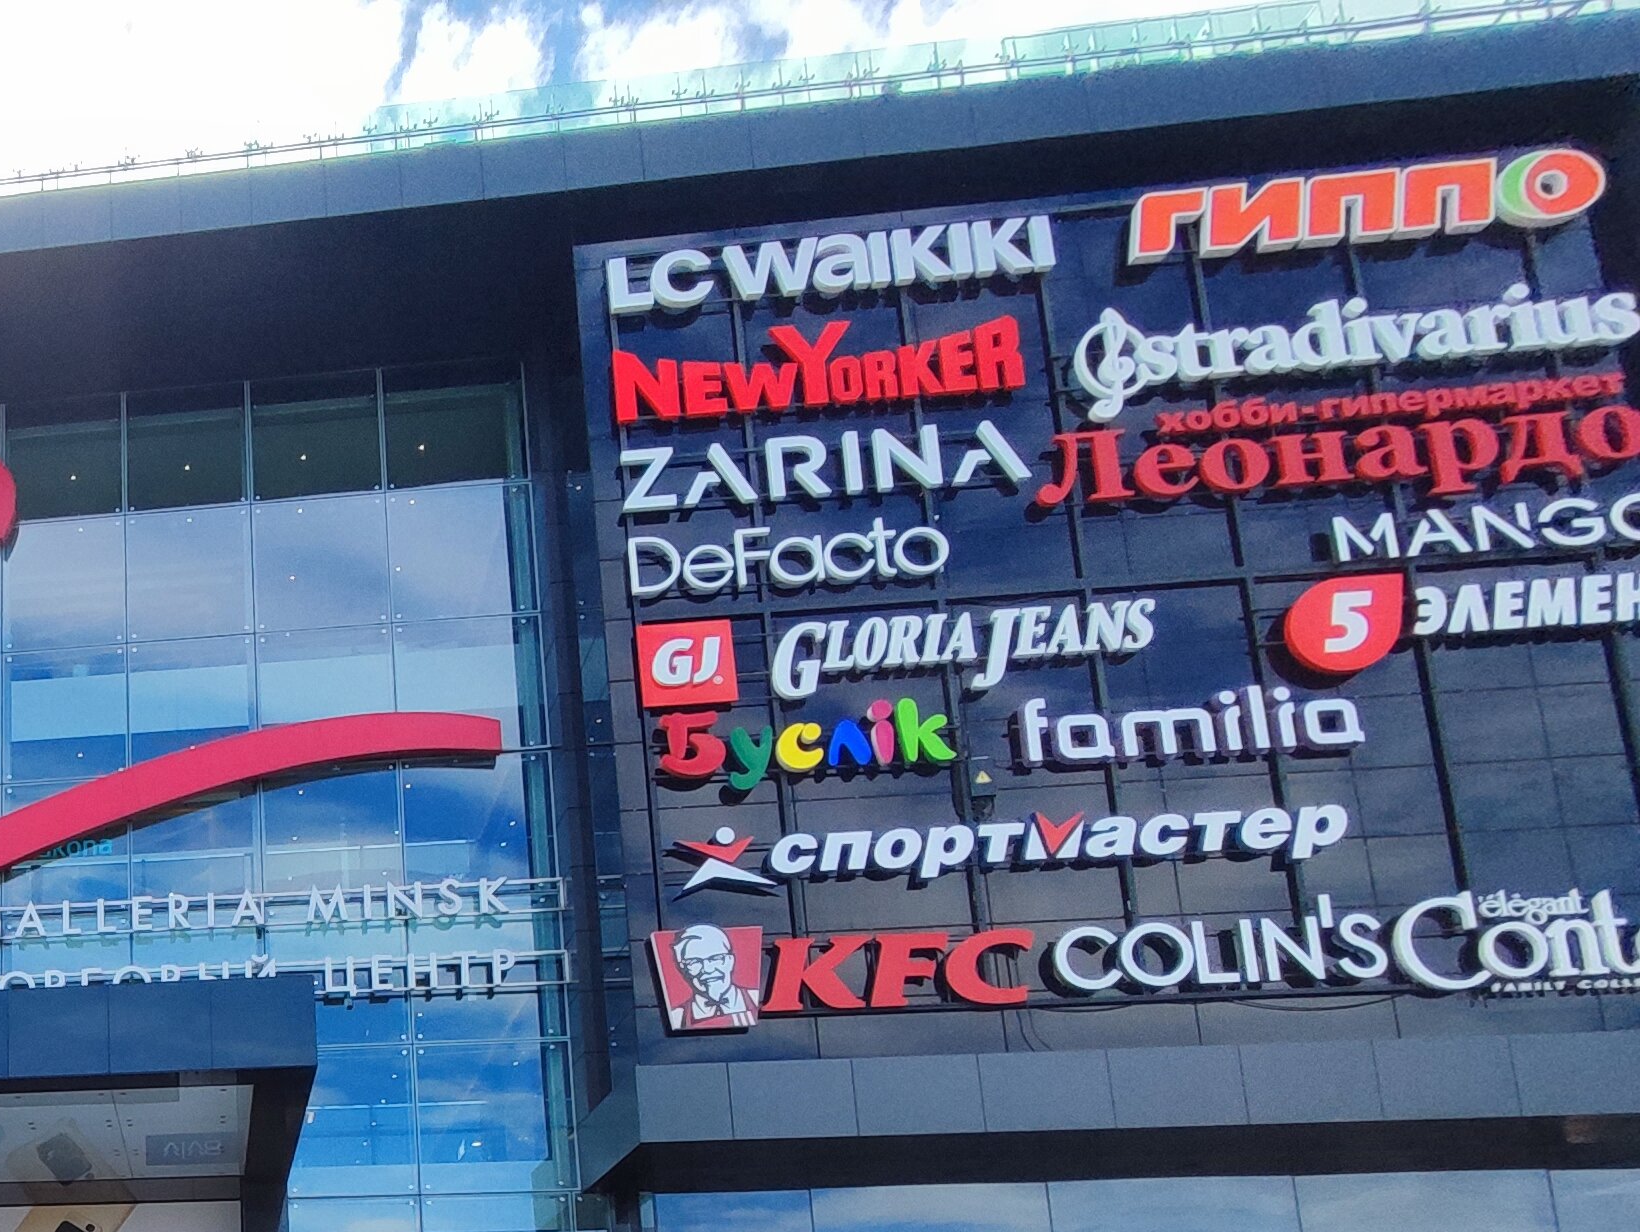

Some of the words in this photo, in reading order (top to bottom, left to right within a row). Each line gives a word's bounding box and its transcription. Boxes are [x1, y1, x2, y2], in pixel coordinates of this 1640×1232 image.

[607, 249, 714, 315] LC
[1133, 282, 1640, 386] stradivarius
[1155, 371, 1626, 436] хобби-гипермаркет
[620, 419, 1032, 512] ZARINA
[1036, 404, 1640, 507] Леонардо
[627, 517, 950, 596] DeFacto
[1324, 590, 1373, 653] 5
[1020, 687, 1363, 765] familia
[307, 875, 512, 925] MINSK
[1392, 888, 1640, 990] Cont
[324, 948, 519, 998] ЦЕНТР
[760, 929, 1035, 1011] KFC
[1053, 893, 1388, 991] COLIN'S
